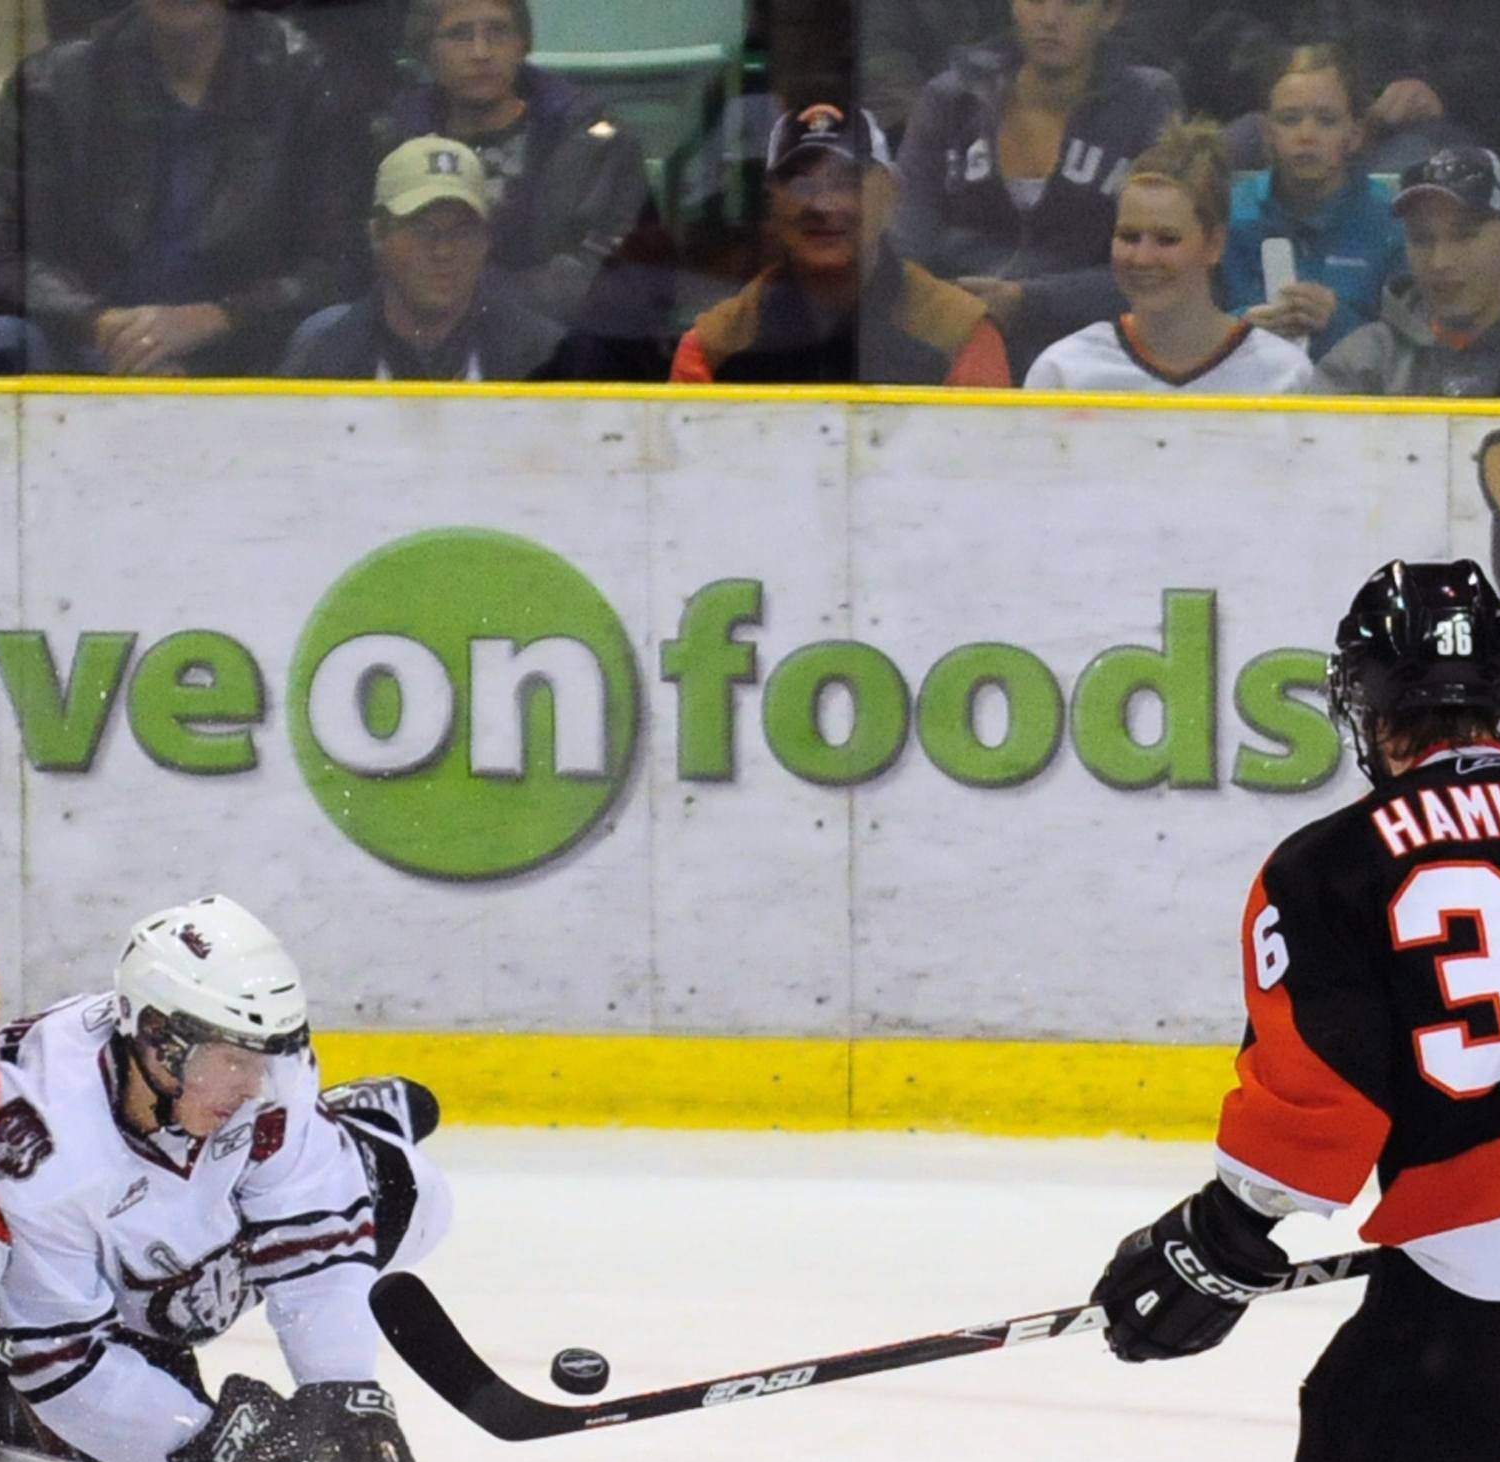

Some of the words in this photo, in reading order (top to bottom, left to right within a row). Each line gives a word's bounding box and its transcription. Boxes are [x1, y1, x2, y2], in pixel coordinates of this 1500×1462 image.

[306, 630, 614, 778] on
[658, 577, 1346, 798] foods
[1436, 622, 1473, 656] 36
